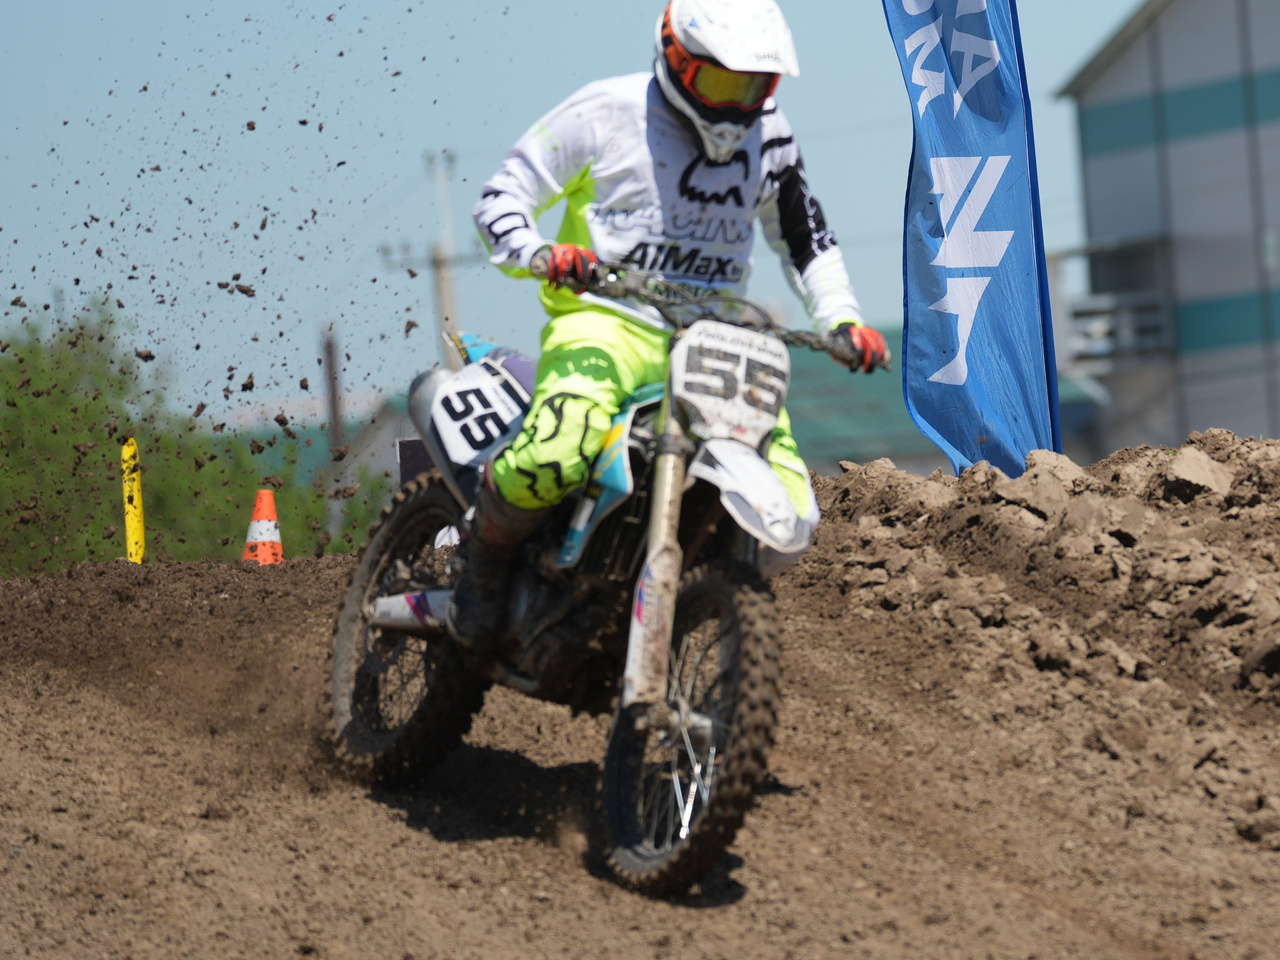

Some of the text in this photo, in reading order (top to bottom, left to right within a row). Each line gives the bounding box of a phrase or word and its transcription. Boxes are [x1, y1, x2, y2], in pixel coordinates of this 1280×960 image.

[583, 204, 752, 245] ACIN
[684, 345, 787, 418] 55
[441, 388, 509, 450] 55
